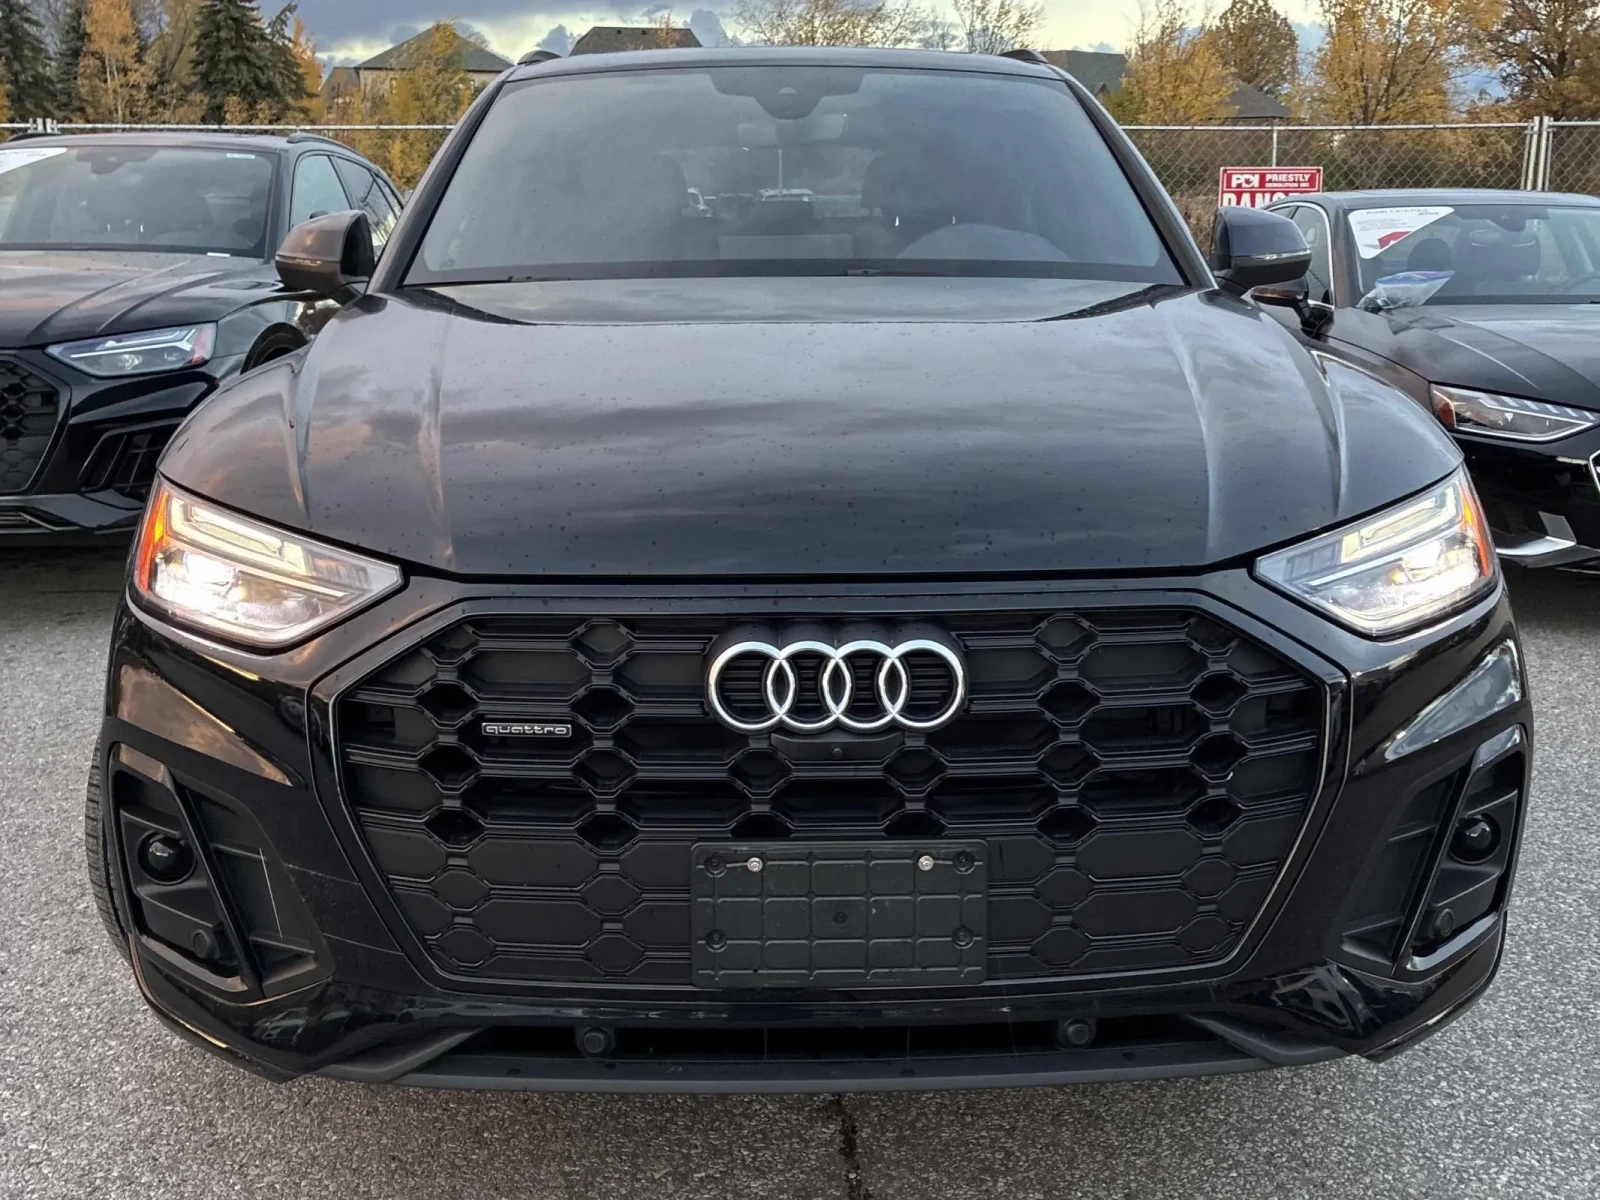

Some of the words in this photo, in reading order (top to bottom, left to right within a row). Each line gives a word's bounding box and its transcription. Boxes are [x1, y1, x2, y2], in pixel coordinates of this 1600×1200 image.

[1231, 173, 1260, 188] PDI
[1265, 173, 1311, 182] PRIESTLY
[485, 725, 568, 735] quattro
